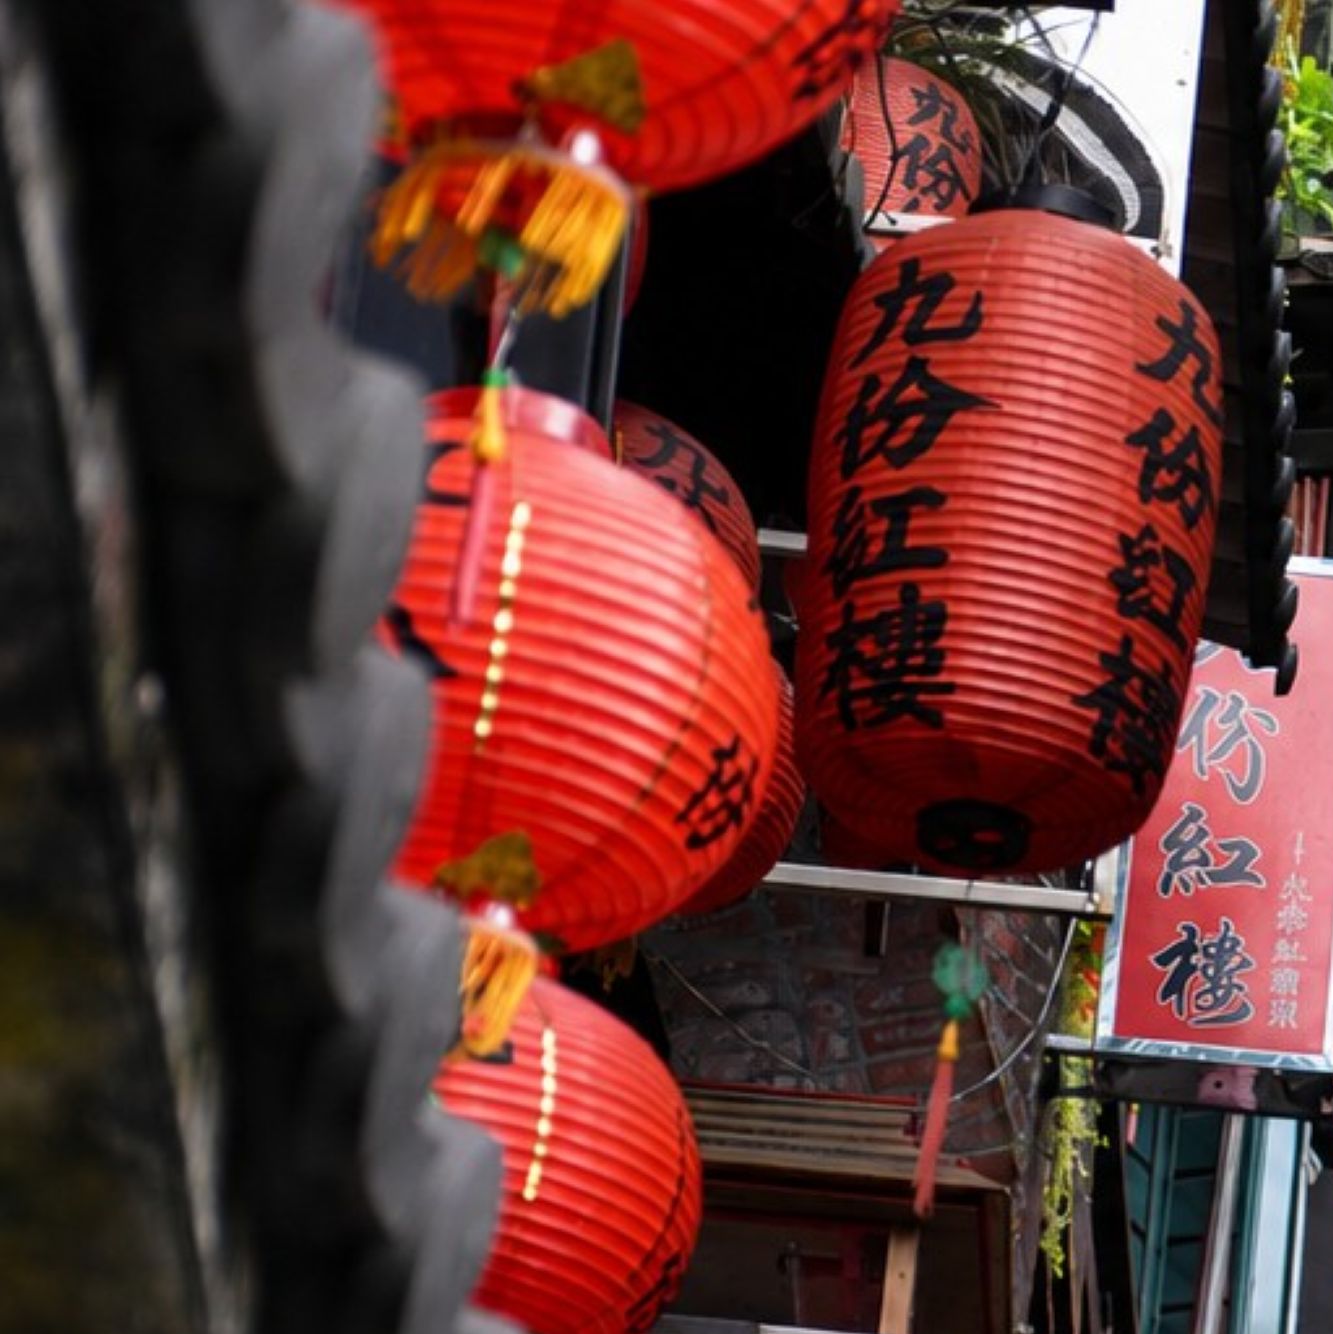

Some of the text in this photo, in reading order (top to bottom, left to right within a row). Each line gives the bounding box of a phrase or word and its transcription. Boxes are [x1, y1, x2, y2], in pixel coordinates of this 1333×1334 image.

[896, 82, 973, 213] 九份
[822, 260, 1003, 733] 九份紅樓
[1152, 638, 1279, 1027] 份紅樓
